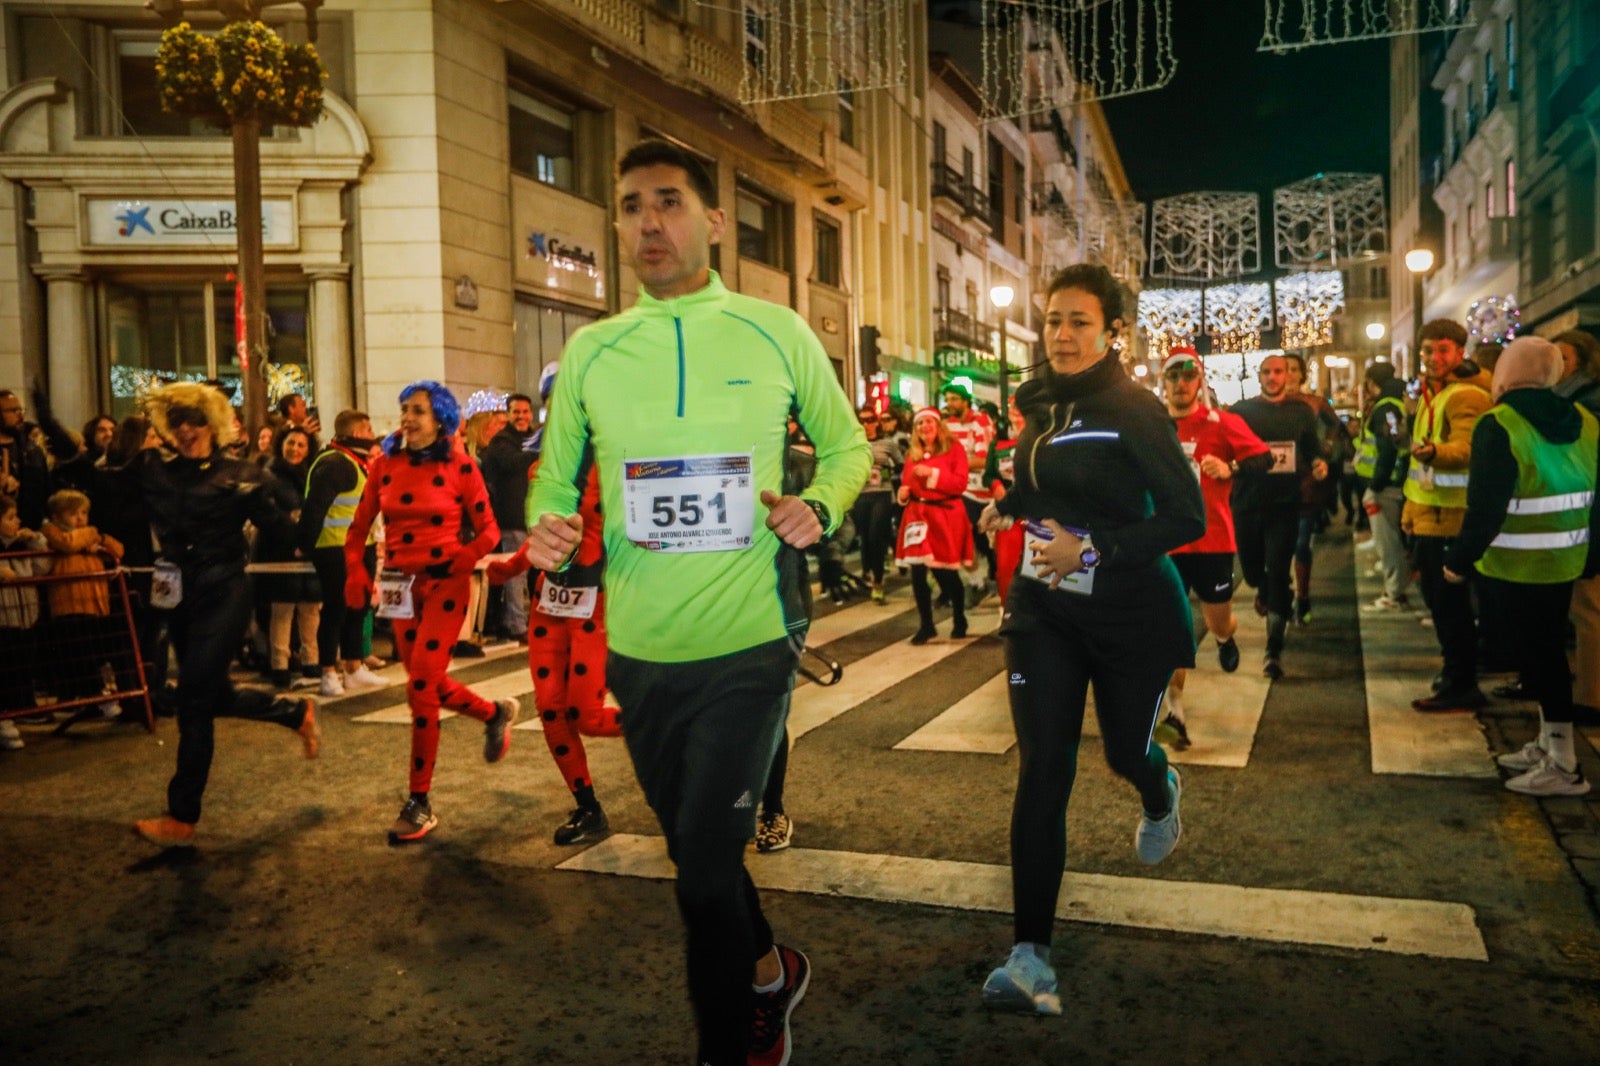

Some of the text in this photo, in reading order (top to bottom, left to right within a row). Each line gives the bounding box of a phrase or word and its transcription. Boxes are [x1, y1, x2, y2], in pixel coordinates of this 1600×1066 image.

[160, 209, 266, 230] CaixaB
[937, 350, 969, 368] 16H
[651, 492, 727, 528] 551
[660, 530, 682, 539] ANTONIO
[549, 587, 584, 606] 907
